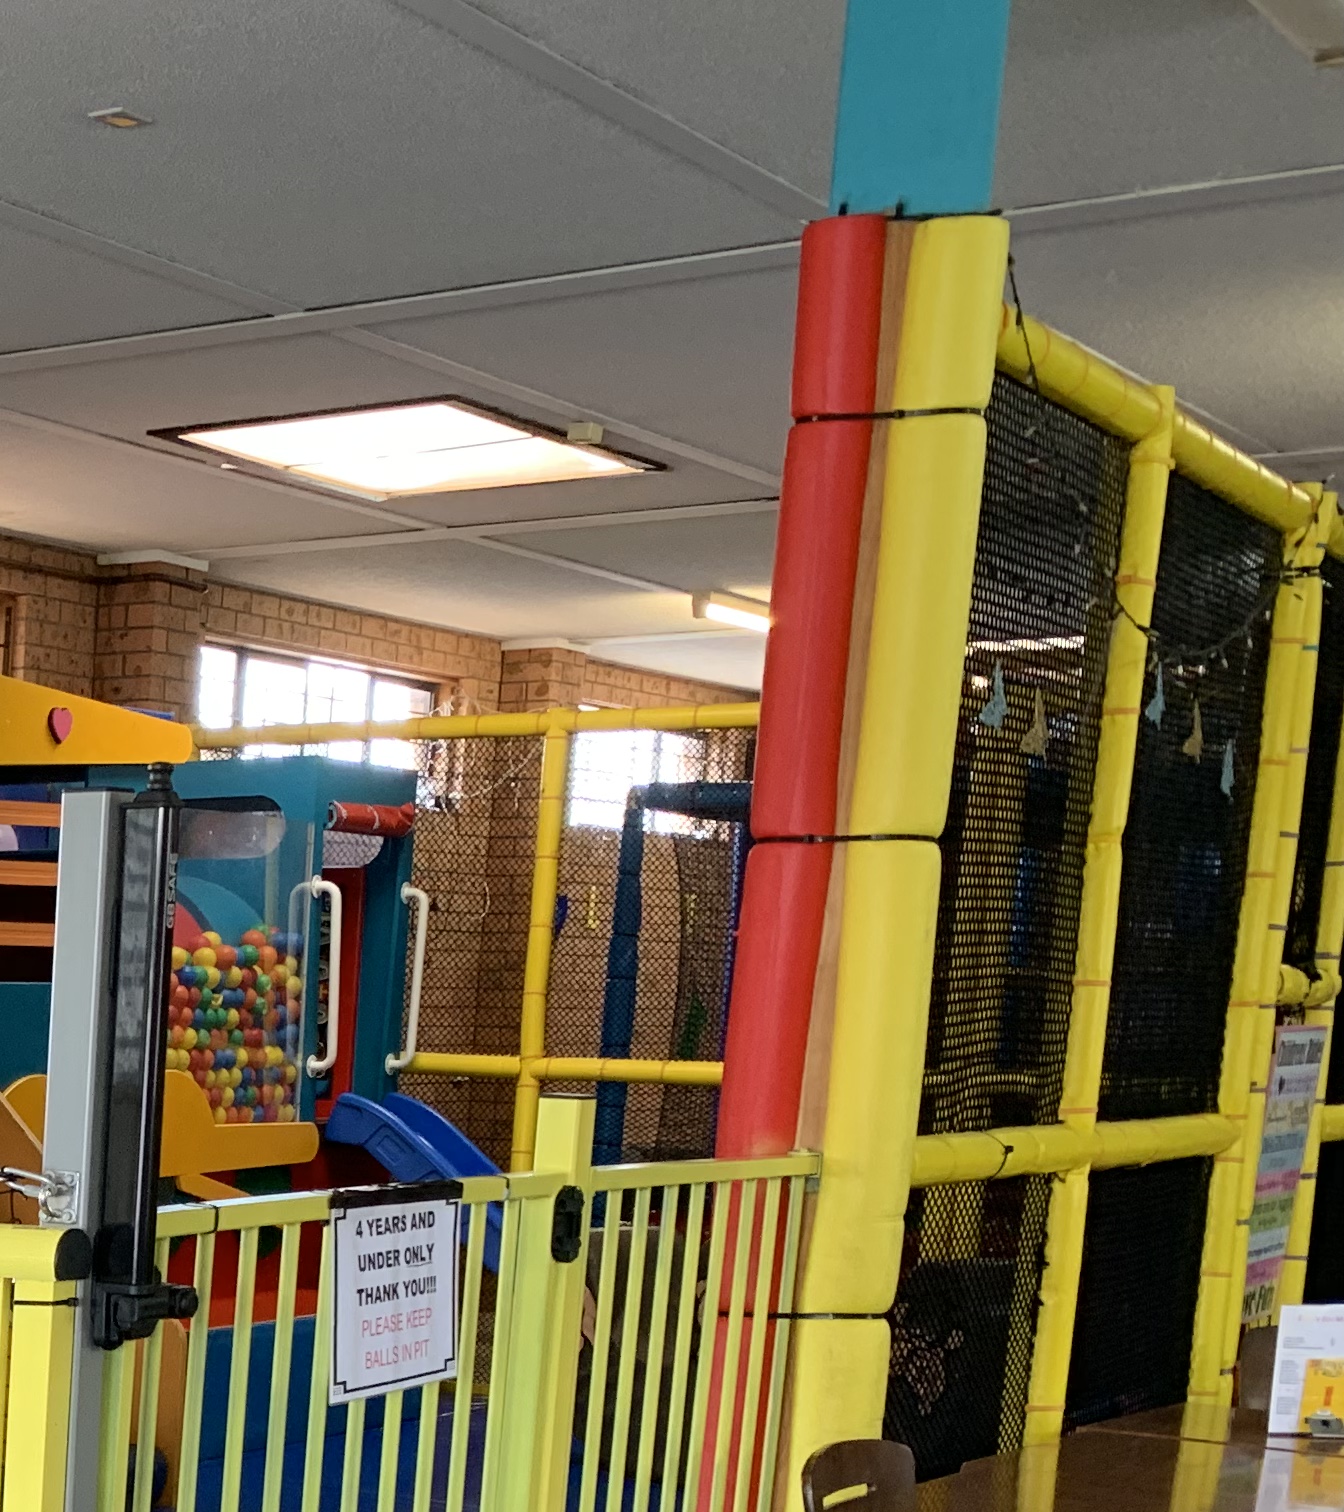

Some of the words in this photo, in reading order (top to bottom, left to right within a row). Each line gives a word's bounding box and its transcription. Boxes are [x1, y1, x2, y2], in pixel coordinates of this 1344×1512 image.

[355, 1221, 364, 1239] 4
[366, 1214, 407, 1236] YEARS
[410, 1211, 436, 1231] AND
[358, 1249, 401, 1272] UNDER
[404, 1243, 435, 1266] ONLY
[356, 1281, 399, 1307] THANK
[402, 1275, 437, 1298] YOU!!!
[362, 1313, 404, 1338] PLEASE
[405, 1307, 433, 1329] KEEP
[365, 1346, 399, 1370] BALLS
[401, 1342, 412, 1362] IN
[414, 1339, 430, 1360] PIT
